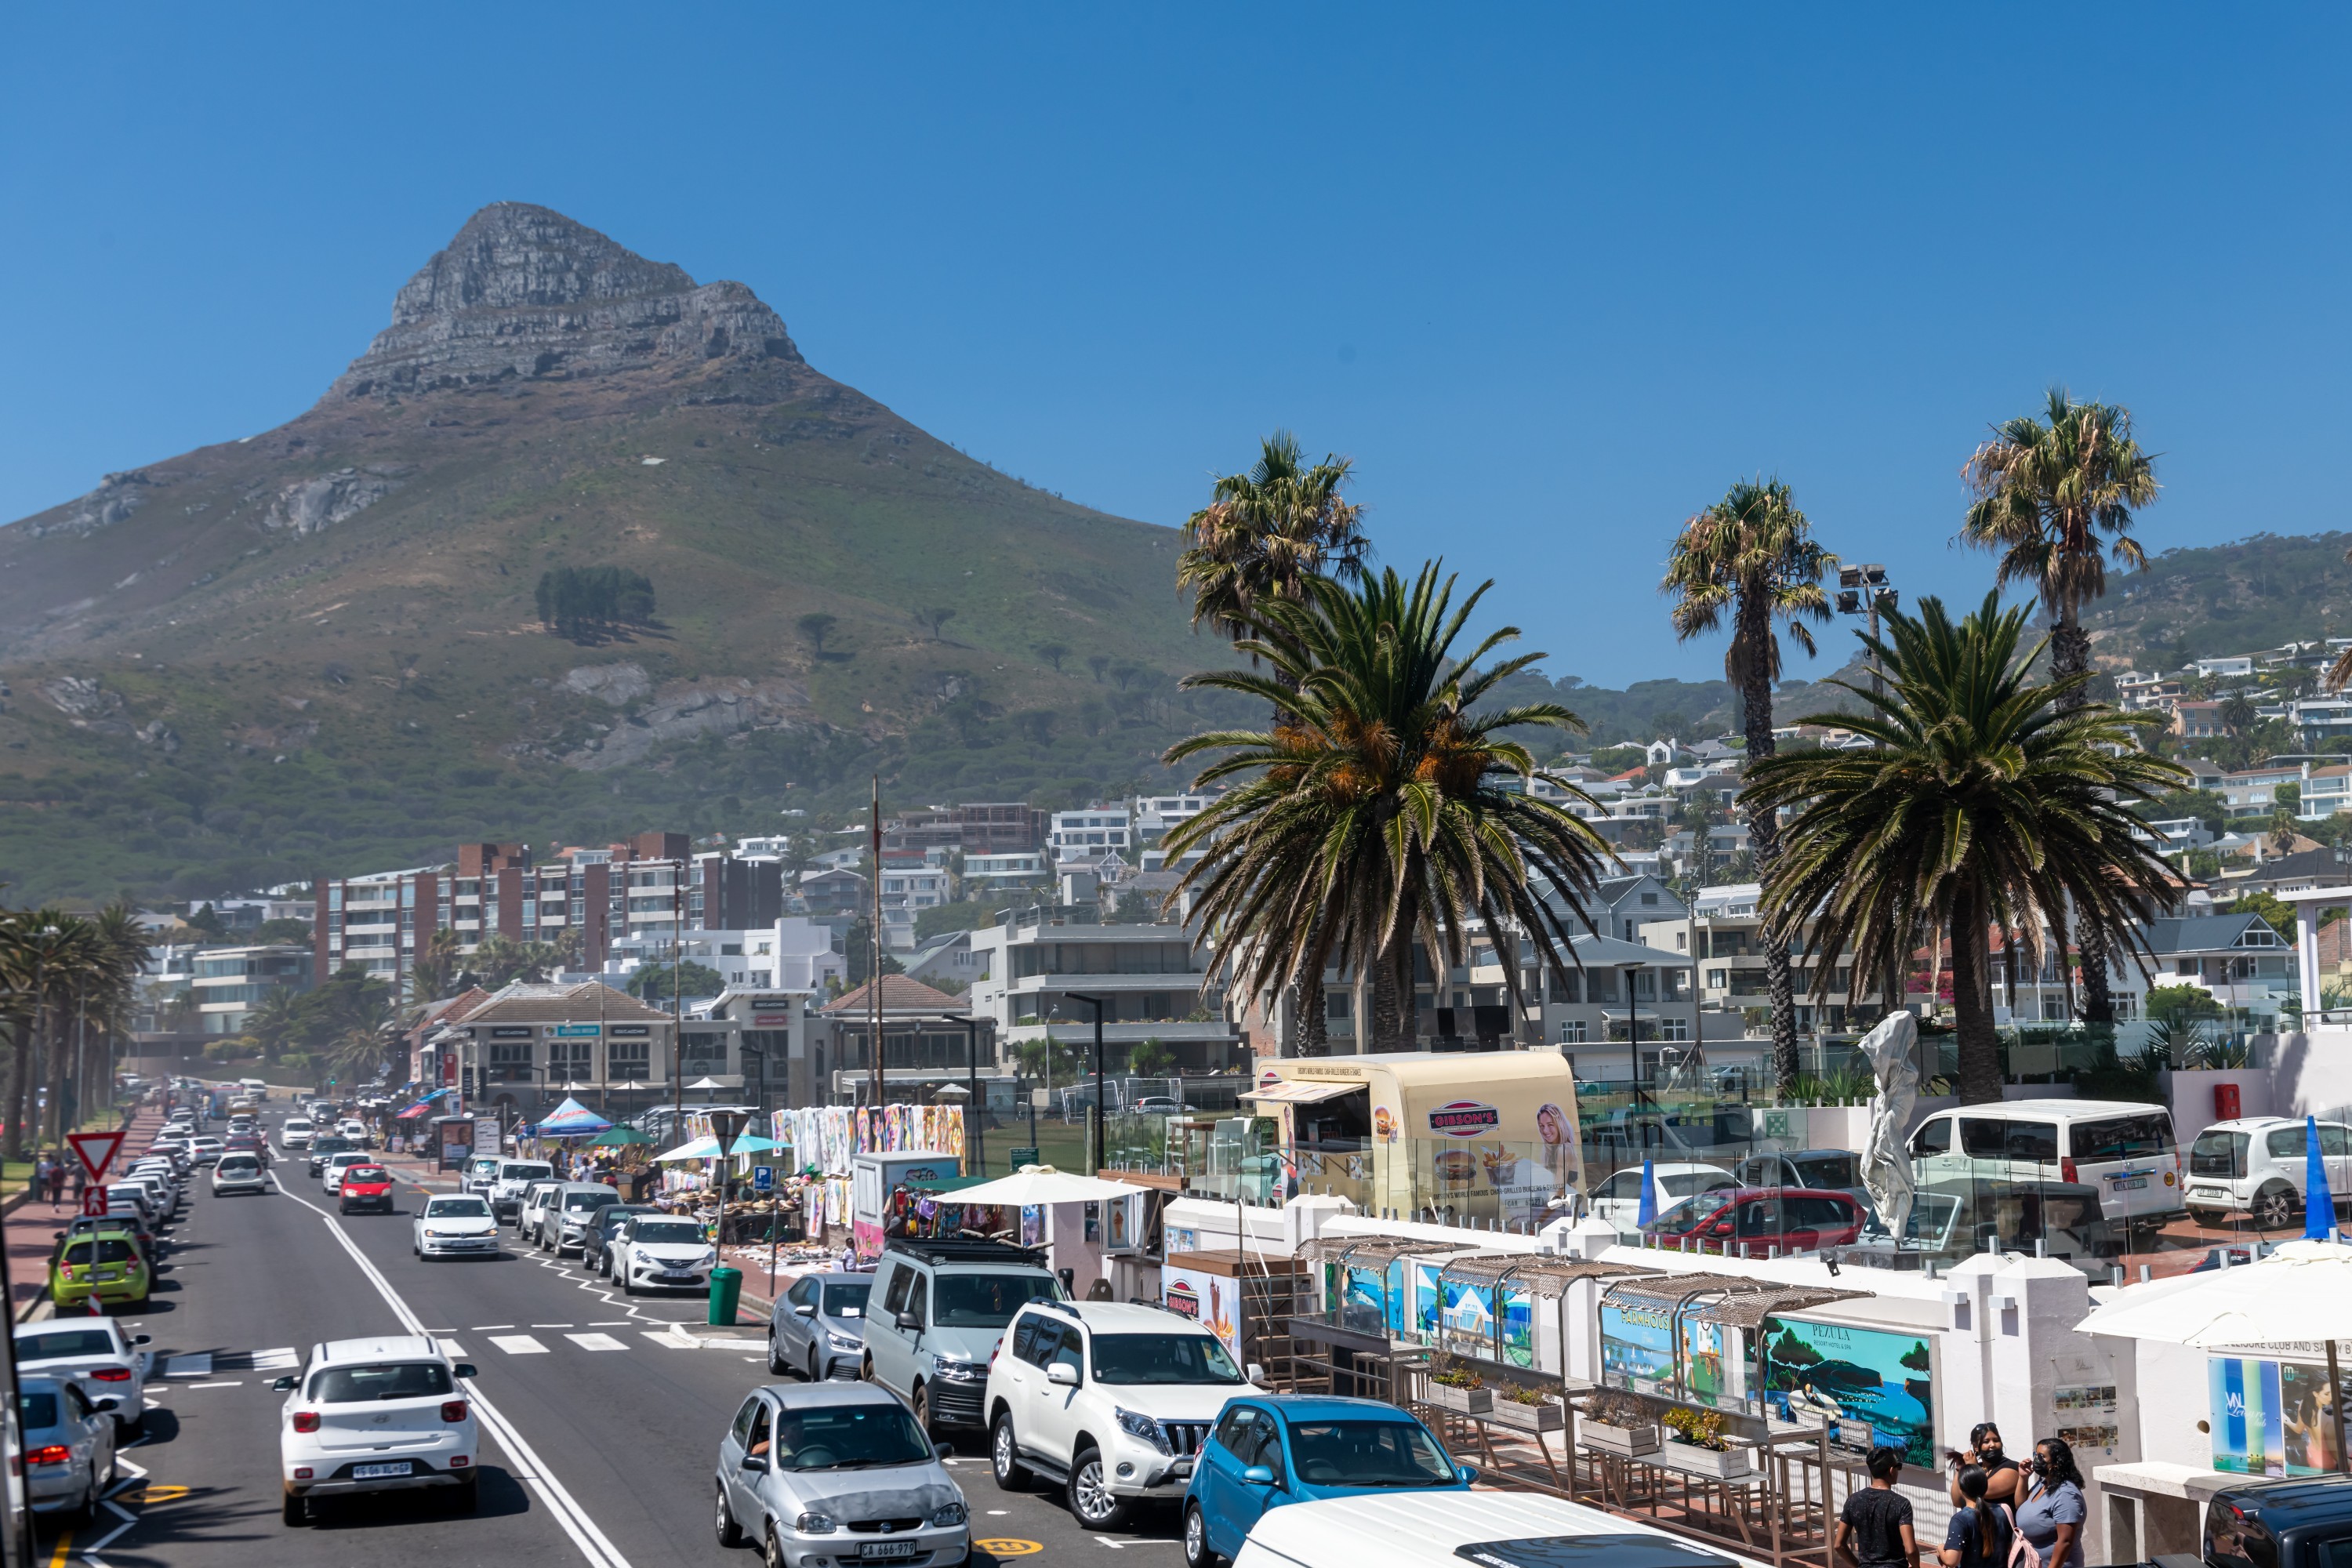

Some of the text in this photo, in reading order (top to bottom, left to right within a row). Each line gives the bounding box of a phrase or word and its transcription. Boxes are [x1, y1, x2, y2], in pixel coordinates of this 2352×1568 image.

[1435, 1112, 1494, 1126] GIBSON'S
[758, 1169, 767, 1179] P
[1168, 1296, 1197, 1314] GIBSON'S
[1813, 1325, 1850, 1341] PEZULA
[2293, 1341, 2310, 1352] AND
[2314, 1342, 2341, 1353] SAY
[863, 1543, 914, 1555] CA 666-979
